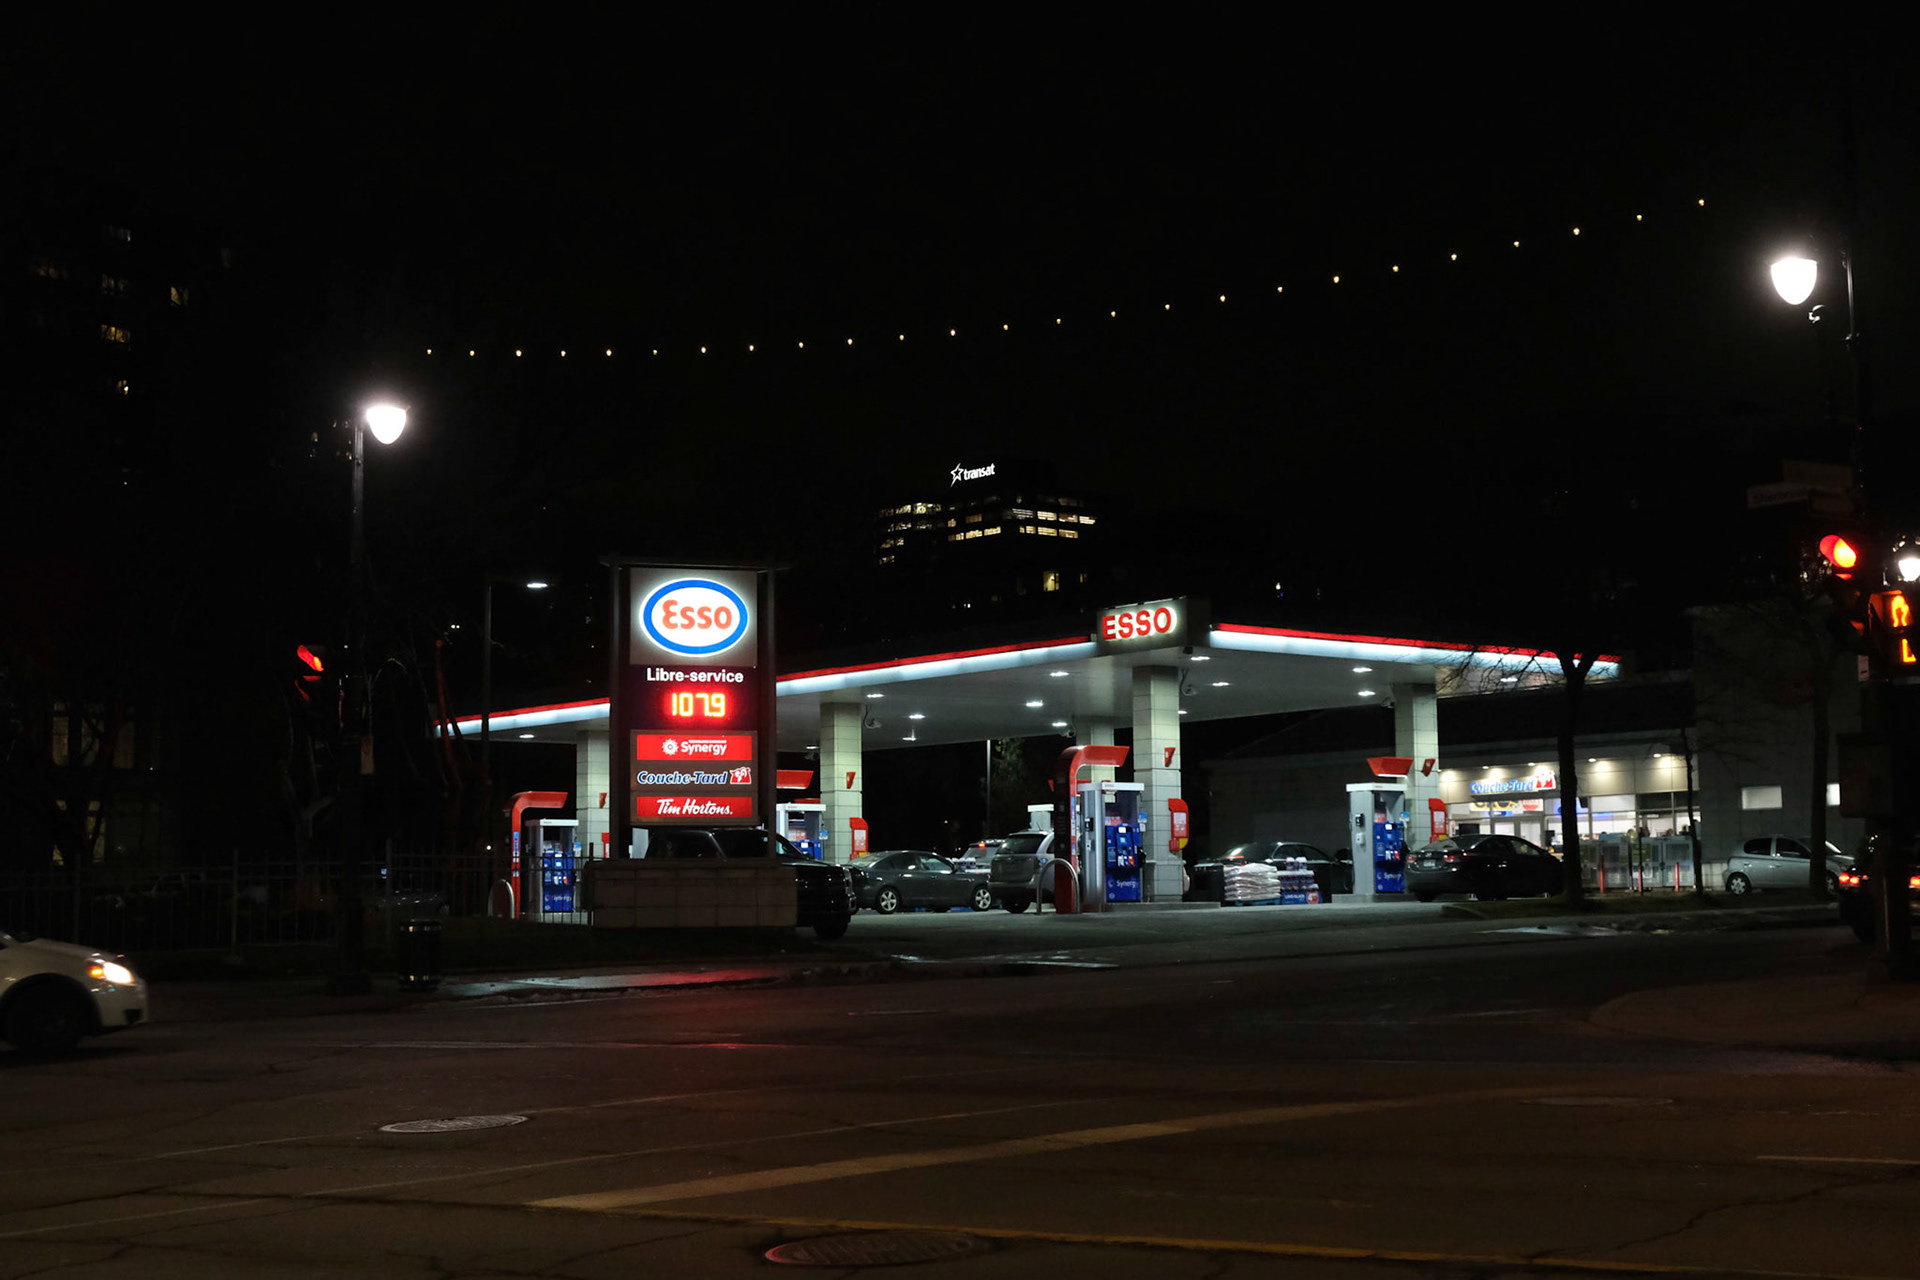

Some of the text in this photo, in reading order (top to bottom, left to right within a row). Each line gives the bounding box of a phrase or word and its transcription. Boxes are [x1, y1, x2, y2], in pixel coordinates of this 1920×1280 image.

[963, 463, 995, 480] transat
[1102, 606, 1172, 640] ESSO
[646, 667, 744, 683] Libre-service
[681, 740, 727, 755] Synergy
[637, 771, 728, 784] Couche-Tard
[1470, 780, 1534, 794] Couche-Tard
[657, 798, 680, 815] Tim
